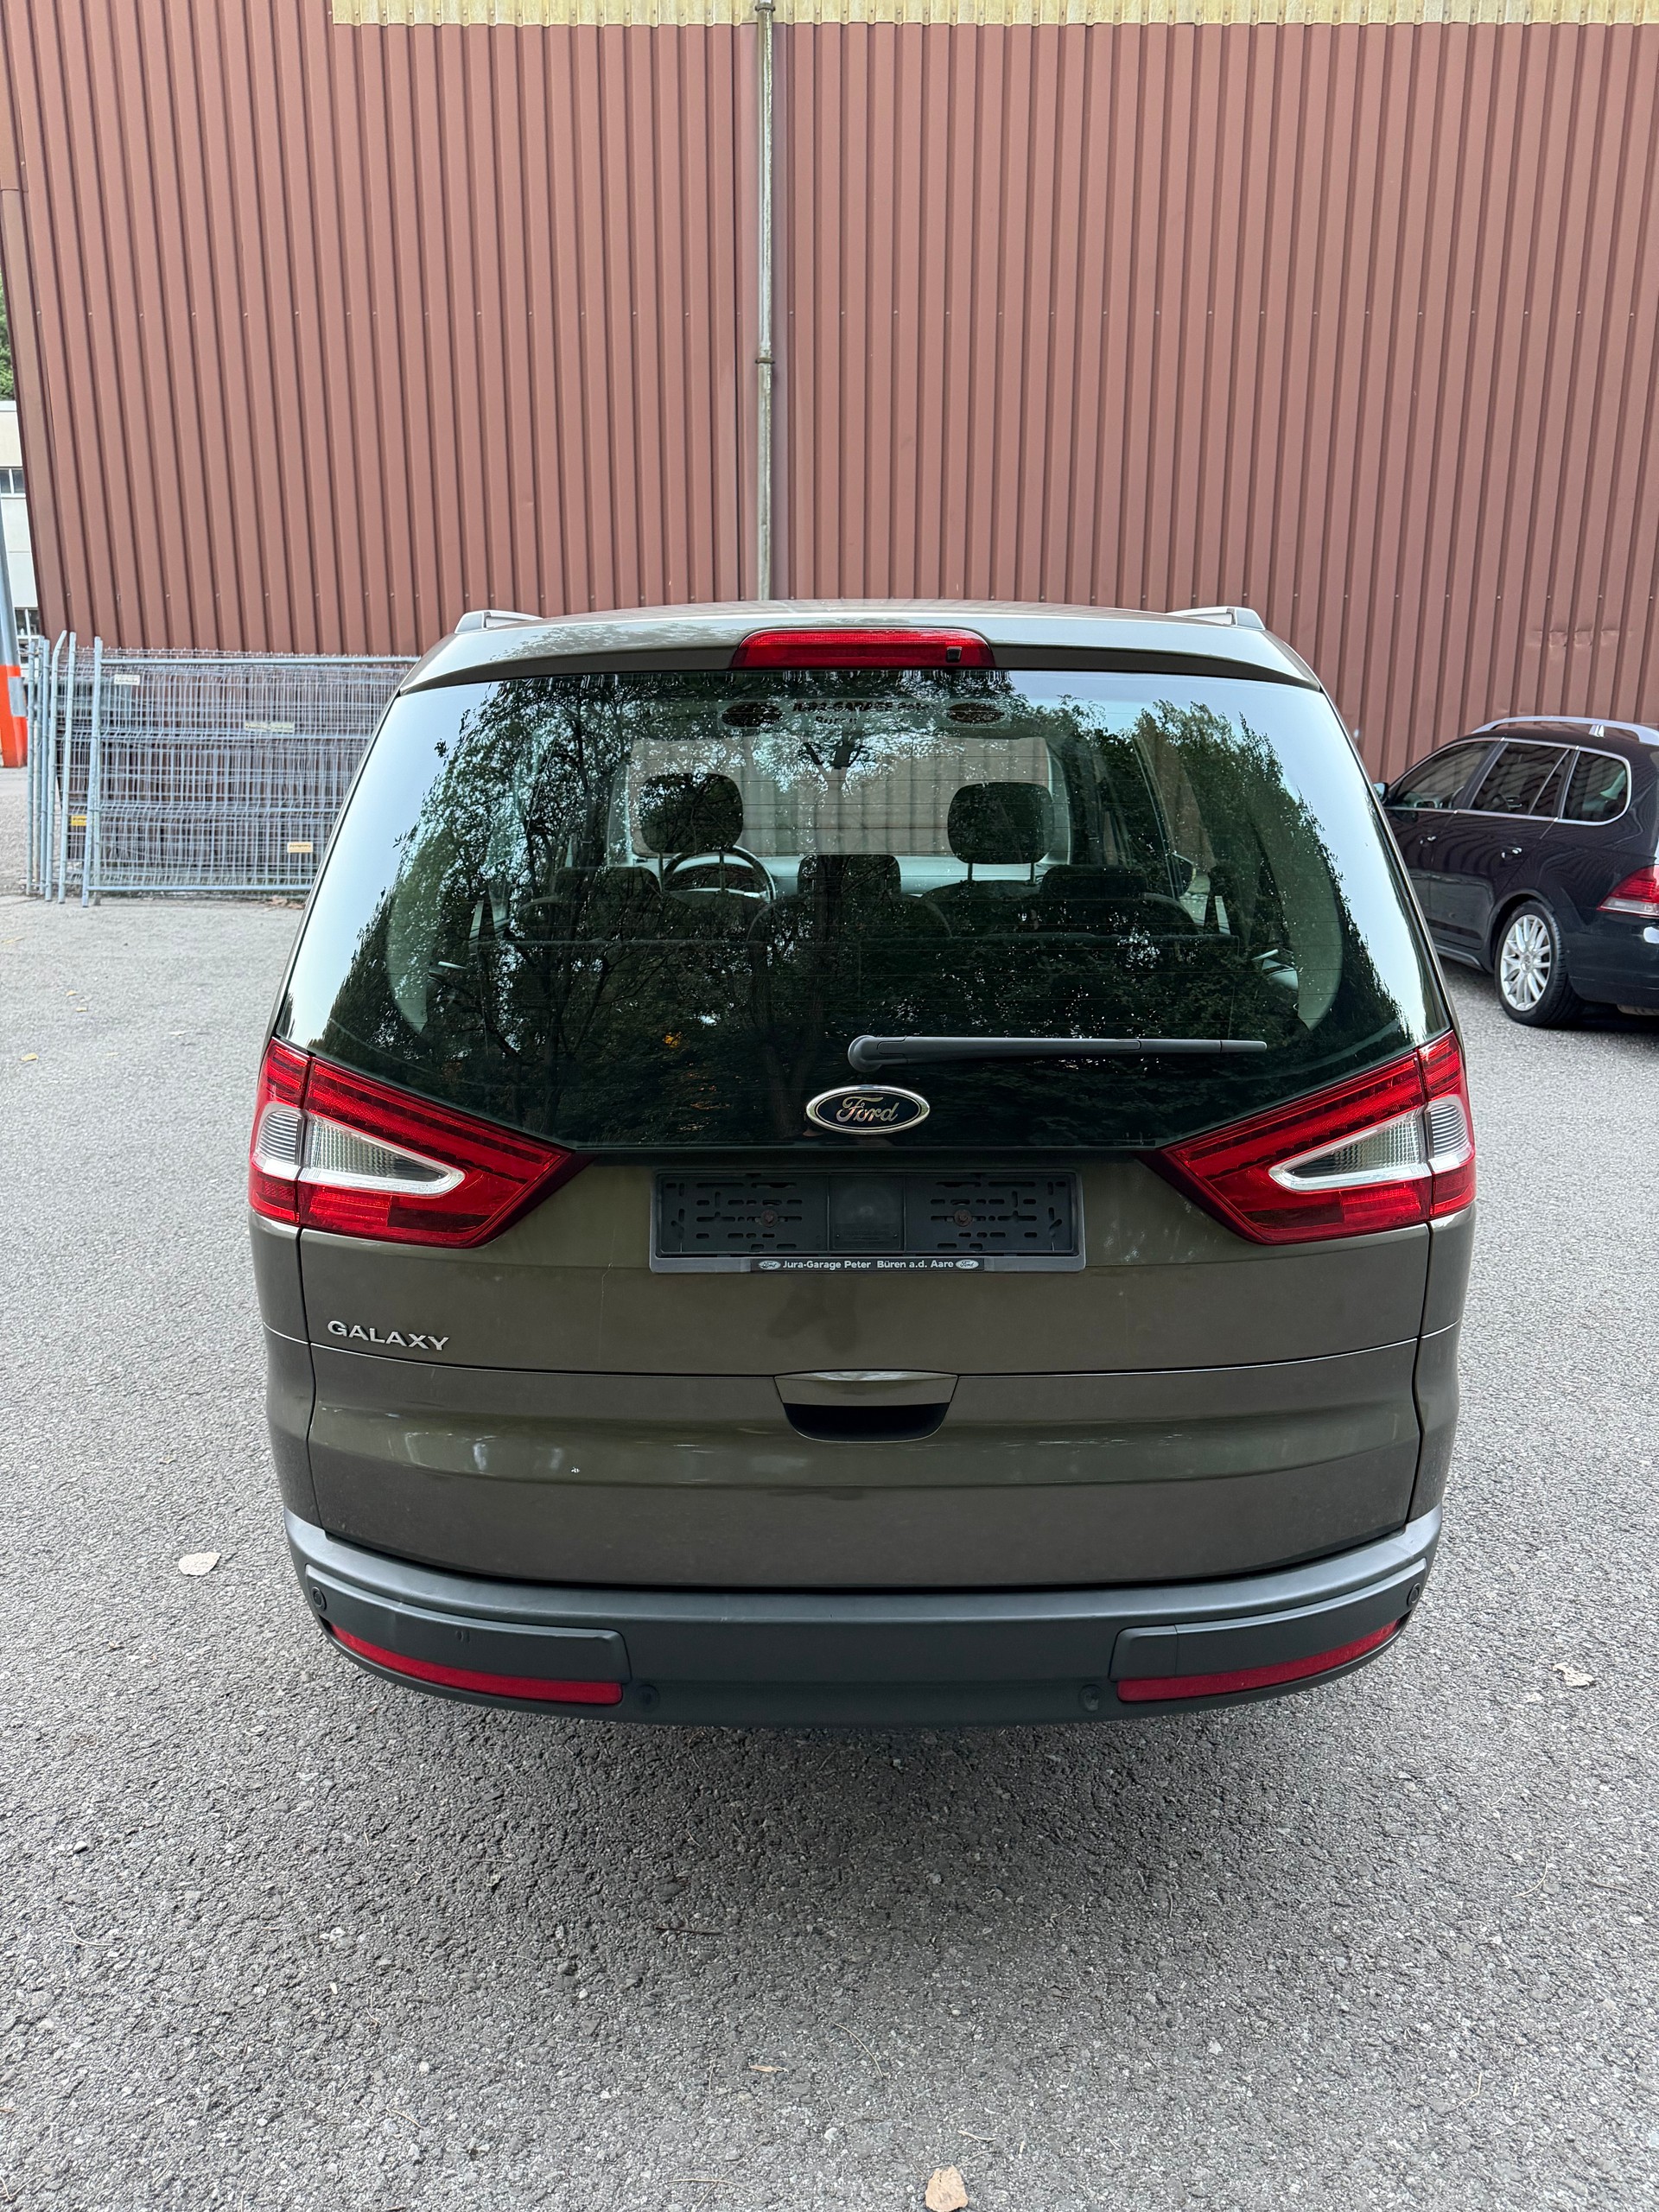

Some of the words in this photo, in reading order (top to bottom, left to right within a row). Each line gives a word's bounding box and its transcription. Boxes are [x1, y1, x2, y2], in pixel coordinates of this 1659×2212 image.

[836, 1096, 899, 1122] Ford
[783, 1260, 842, 1271] Jura-Garage
[877, 1259, 906, 1268] Büren
[909, 1260, 928, 1268] a.d.
[931, 1260, 954, 1268] Aare
[327, 1320, 449, 1351] GALAXY
